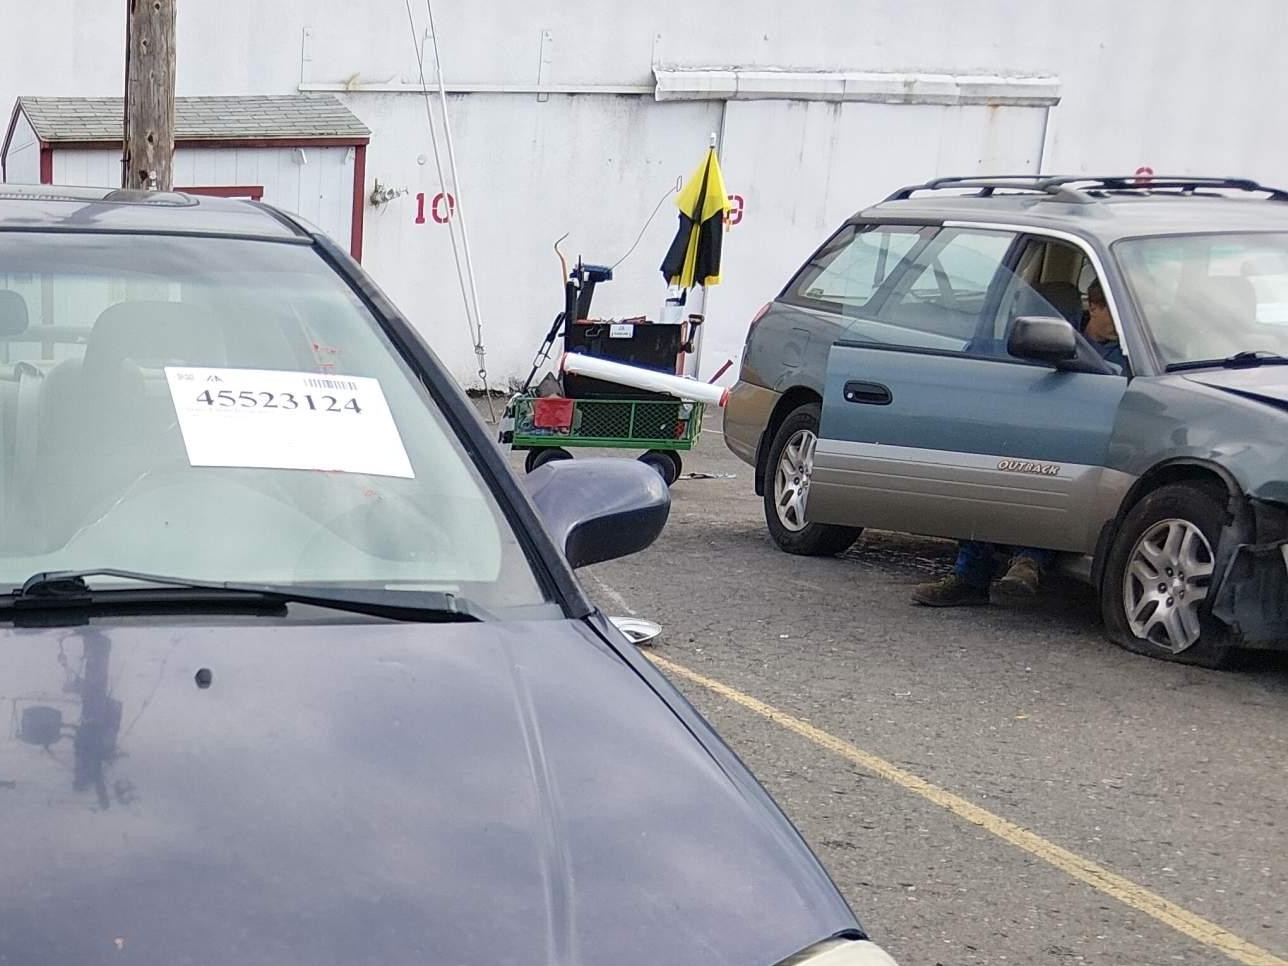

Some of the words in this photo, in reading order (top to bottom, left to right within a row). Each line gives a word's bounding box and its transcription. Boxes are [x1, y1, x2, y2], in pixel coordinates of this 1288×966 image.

[415, 192, 454, 224] 10
[196, 388, 363, 415] 45523124
[997, 459, 1061, 476] OUTBACK
